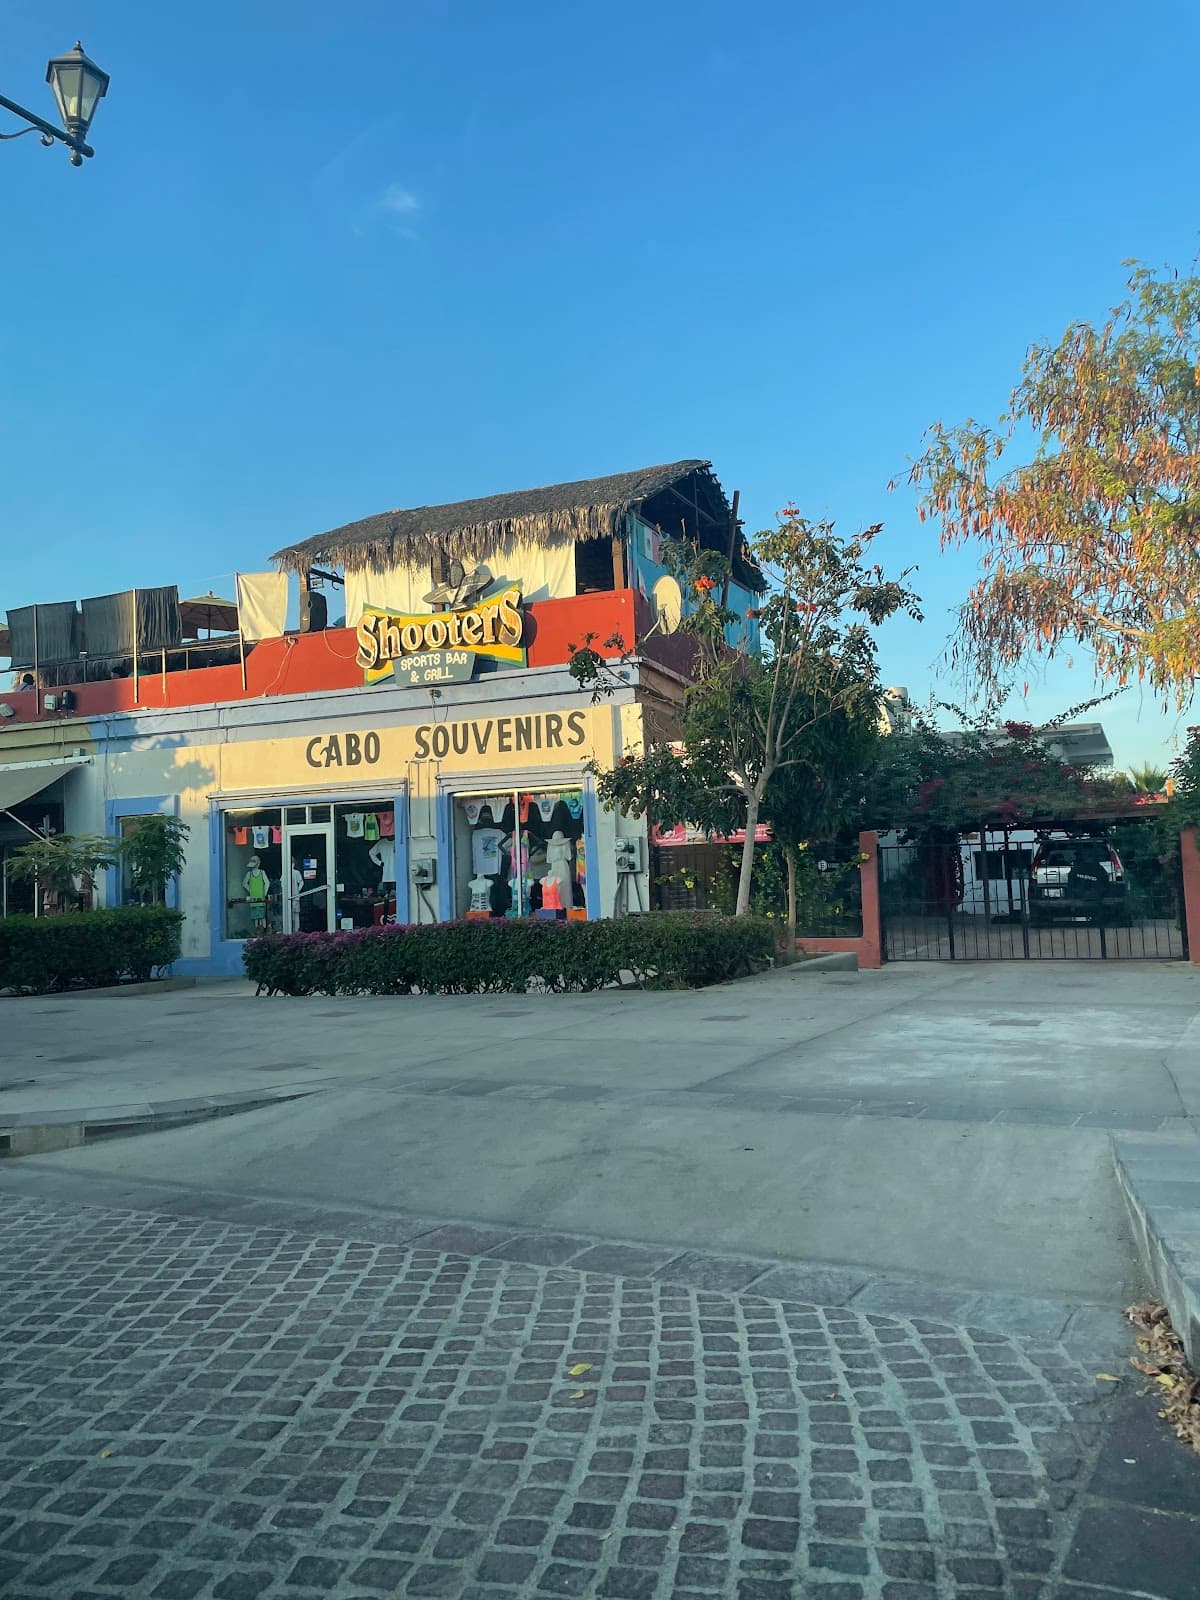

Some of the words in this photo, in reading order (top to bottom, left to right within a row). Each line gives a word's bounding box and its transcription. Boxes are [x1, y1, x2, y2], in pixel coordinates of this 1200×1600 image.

[400, 653, 441, 671] SPORTS
[446, 652, 468, 665] BAR
[410, 670, 420, 683] &
[424, 668, 454, 682] GRILL
[306, 731, 381, 768] CABO
[414, 711, 586, 760] SOUVENIRS
